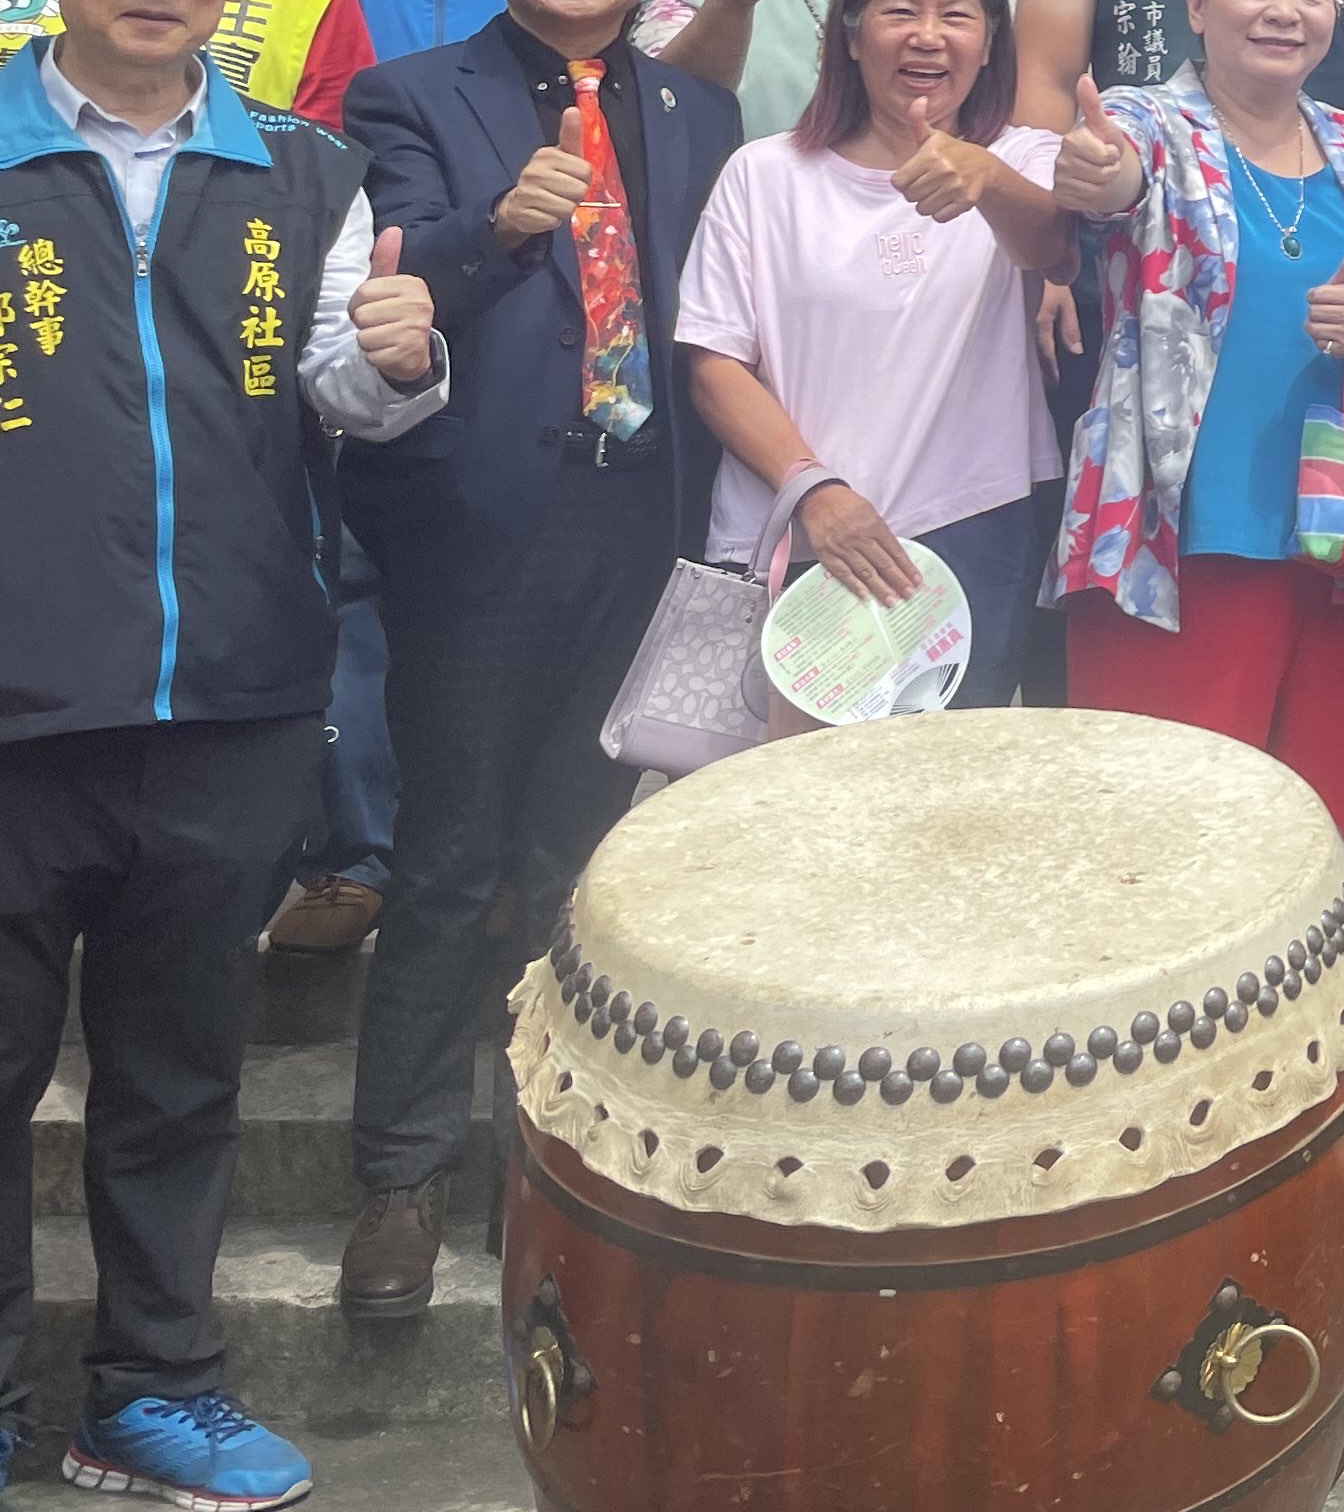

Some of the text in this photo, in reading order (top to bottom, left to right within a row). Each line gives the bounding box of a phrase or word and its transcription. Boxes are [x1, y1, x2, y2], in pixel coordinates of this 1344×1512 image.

[18, 238, 68, 356] 總幹事
[239, 217, 286, 397] 高原社區
